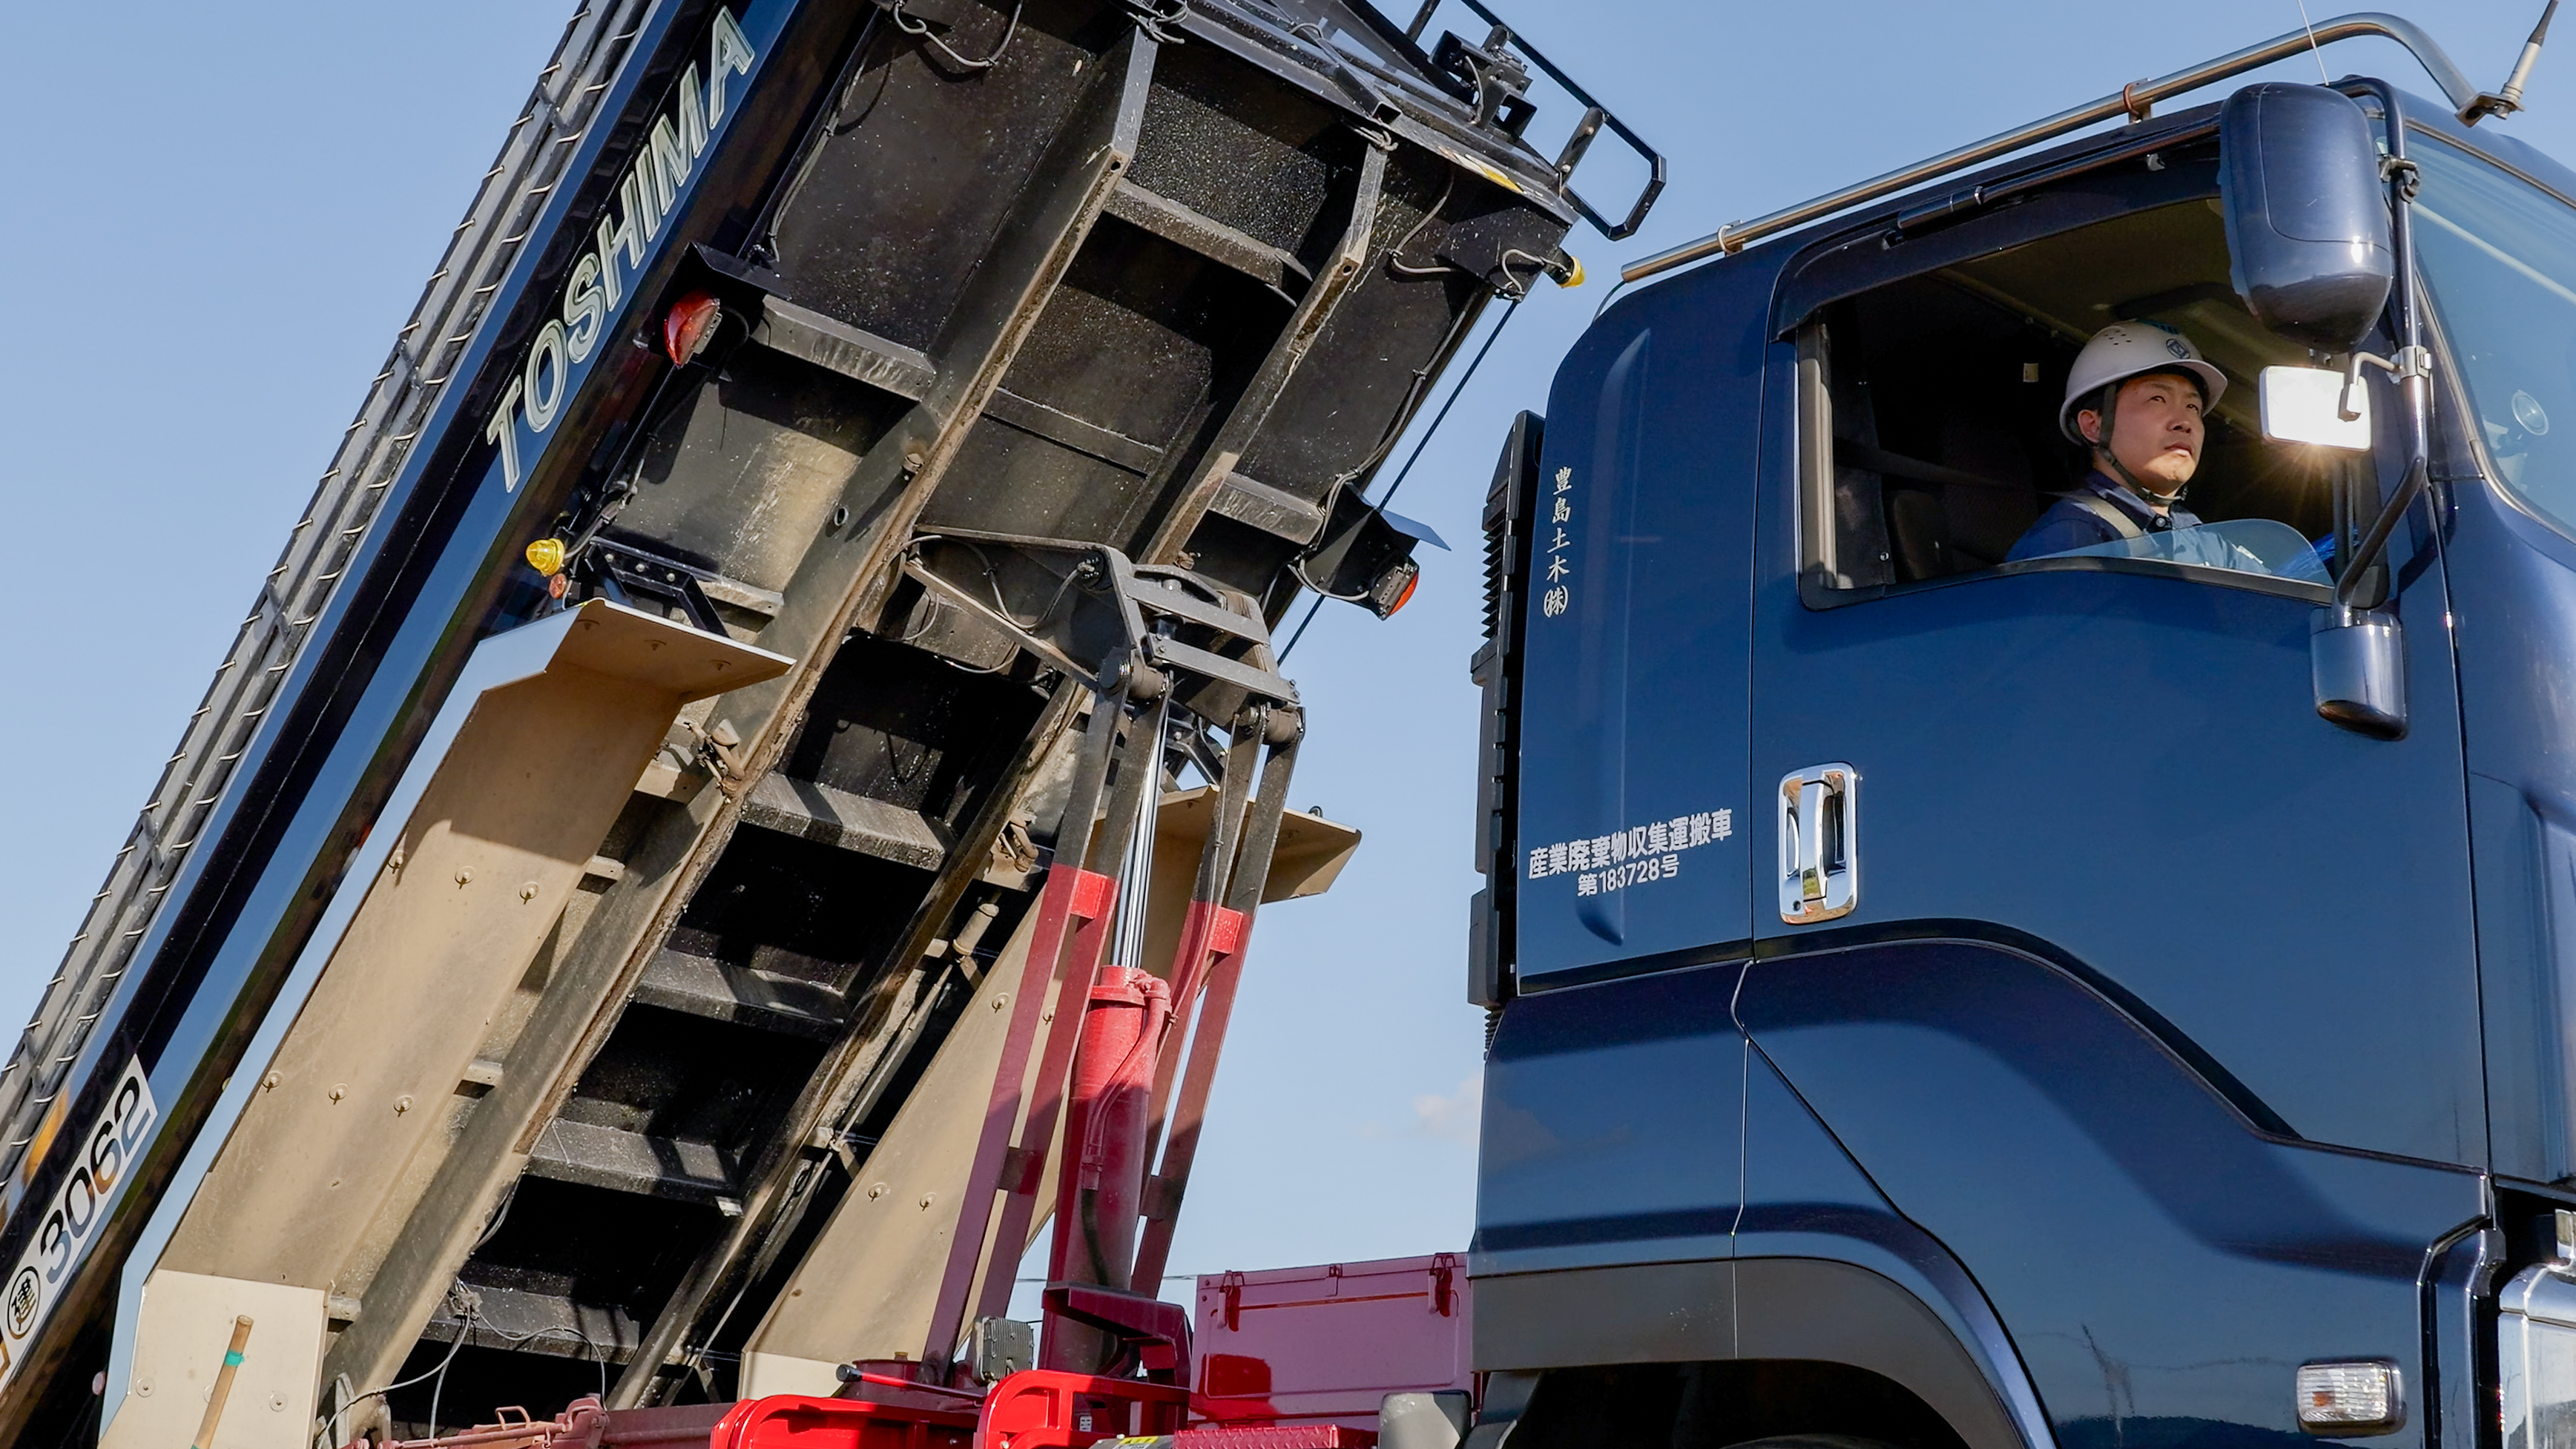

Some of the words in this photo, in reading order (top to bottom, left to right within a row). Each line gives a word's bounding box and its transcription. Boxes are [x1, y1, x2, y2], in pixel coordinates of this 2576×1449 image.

[487, 5, 756, 494] TOSHIMA
[1529, 808, 1733, 879] 産業廃棄物収集運搬車
[1577, 854, 1680, 897] 第183728号
[40, 1075, 151, 1284] 3062
